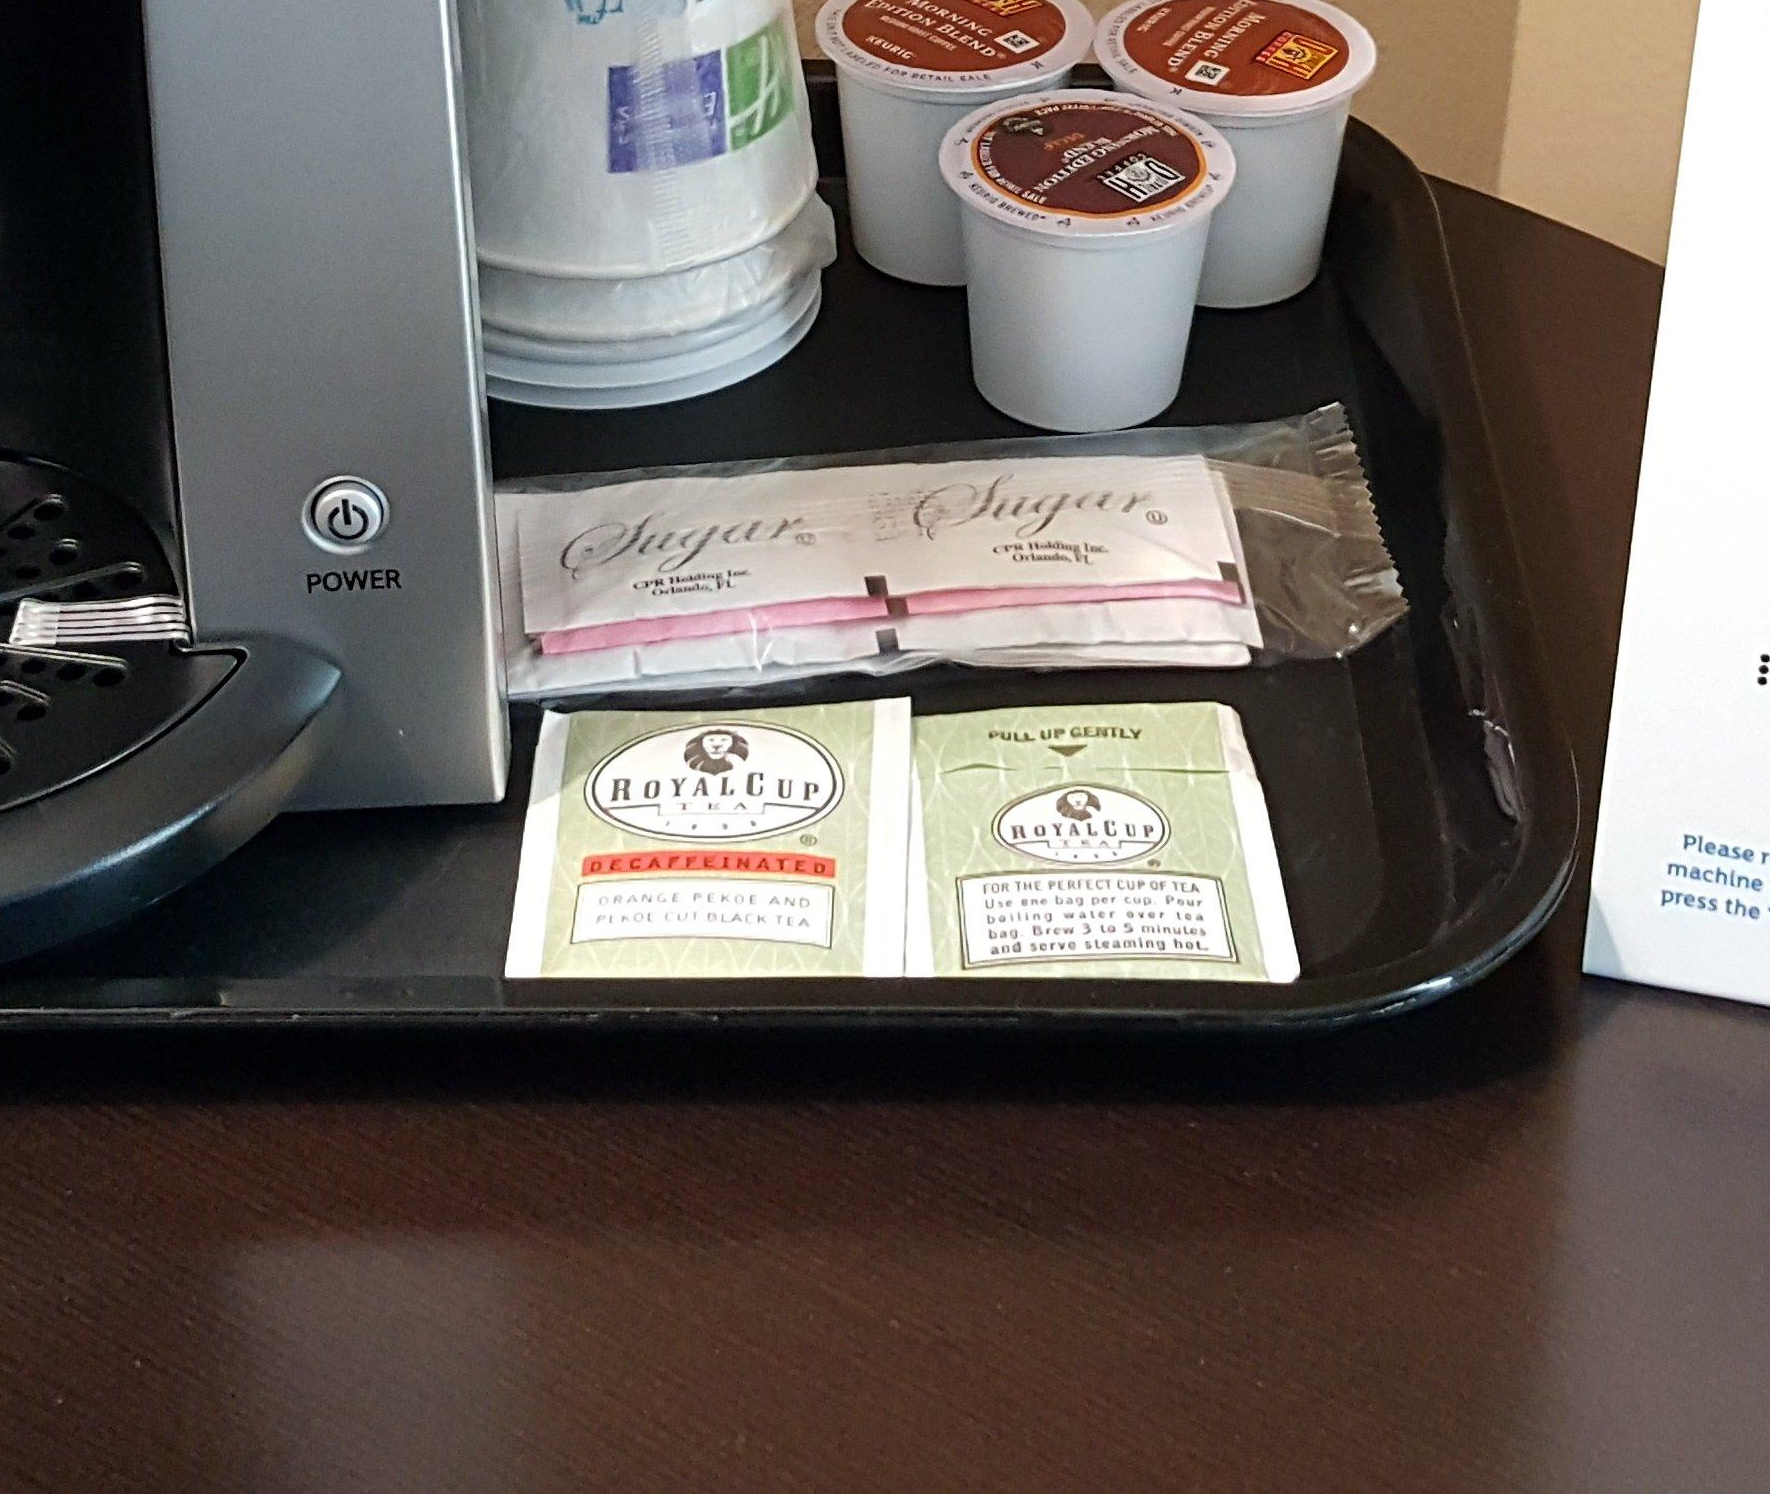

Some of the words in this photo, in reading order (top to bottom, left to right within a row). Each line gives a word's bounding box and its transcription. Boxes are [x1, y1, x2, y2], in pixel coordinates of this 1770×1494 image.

[1204, 11, 1267, 59] MORNING
[866, 35, 916, 60] KEURIG
[1033, 154, 1096, 193] EDITION
[913, 474, 1151, 540] Sugar
[560, 508, 804, 583] Sugar
[1028, 541, 1082, 555] Holding
[1012, 551, 1072, 564] Orlando,
[306, 568, 402, 594] POWER
[669, 571, 723, 587] Holding
[651, 581, 713, 597] Orlando,
[988, 729, 1036, 742] PULL
[1040, 727, 1065, 740] UP
[1070, 726, 1142, 741] GENTLY
[1683, 834, 1754, 862] Please
[589, 856, 827, 875] DECAFFEINATED
[1667, 862, 1763, 891] machine
[983, 883, 1009, 894] FOR
[1014, 880, 1042, 892] THE
[1048, 879, 1112, 891] PERFECT
[1116, 880, 1146, 891] CUP
[1149, 880, 1168, 892] OF
[1173, 881, 1200, 894] TEA
[598, 892, 680, 906] ORANGE
[693, 892, 758, 906] PEKOE
[769, 896, 810, 908] AND
[984, 897, 1013, 910] Use
[1020, 897, 1047, 908] one
[1054, 894, 1085, 908] bag
[1090, 895, 1118, 908] per
[1165, 895, 1203, 908] Pour
[1660, 889, 1718, 912] press
[1725, 899, 1761, 920] the
[664, 911, 699, 924] CUT
[707, 911, 767, 926] BLACK
[776, 914, 810, 928] TEA
[987, 910, 1053, 925] boiling
[1063, 909, 1116, 921] water
[1126, 910, 1165, 921] over
[1176, 910, 1204, 922] tea
[988, 926, 1024, 941] bag.
[1032, 924, 1074, 937] Brew
[1081, 922, 1092, 935] 3
[1100, 923, 1117, 935] to
[1124, 922, 1135, 935] 5
[1140, 924, 1207, 937] minutes
[990, 941, 1022, 956] and
[1030, 940, 1076, 953] serve
[1084, 937, 1166, 952] steaming
[1173, 937, 1209, 952] hot.
